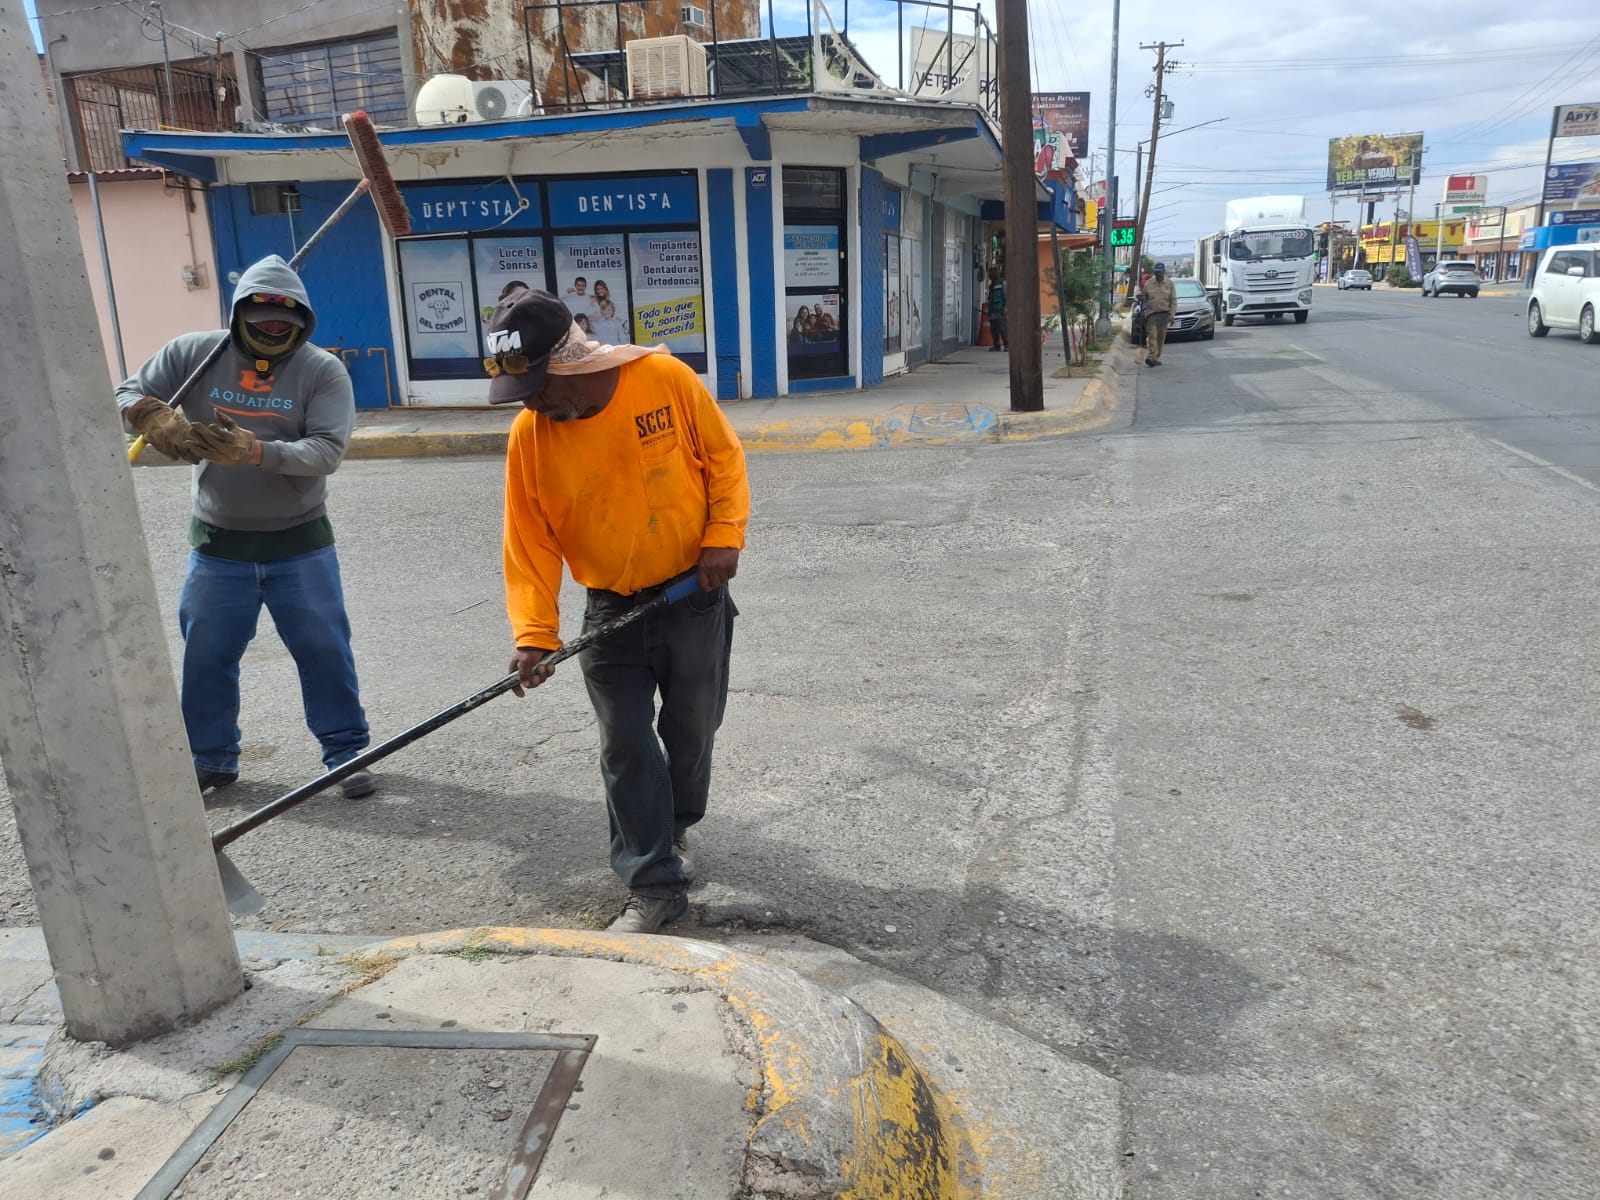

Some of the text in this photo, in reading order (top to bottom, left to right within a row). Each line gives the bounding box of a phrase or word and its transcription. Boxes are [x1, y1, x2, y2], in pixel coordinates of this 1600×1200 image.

[422, 199, 514, 218] DENTSTA
[569, 245, 622, 257] Implantes
[649, 240, 698, 252] Implantes
[499, 247, 537, 258] Luce tu
[659, 252, 699, 262] Coronas
[499, 260, 538, 270] Sonrisa
[576, 258, 623, 269] Dentales
[643, 264, 699, 274] Dentaduras
[647, 276, 700, 286] Ortodoncia
[418, 287, 456, 301] DENTAL
[637, 301, 694, 320] Todo lo que
[418, 316, 464, 330] DEL CENTRO
[644, 311, 696, 329] tu sonrisa
[651, 320, 695, 338] necesita
[209, 387, 294, 410] AQUATICS
